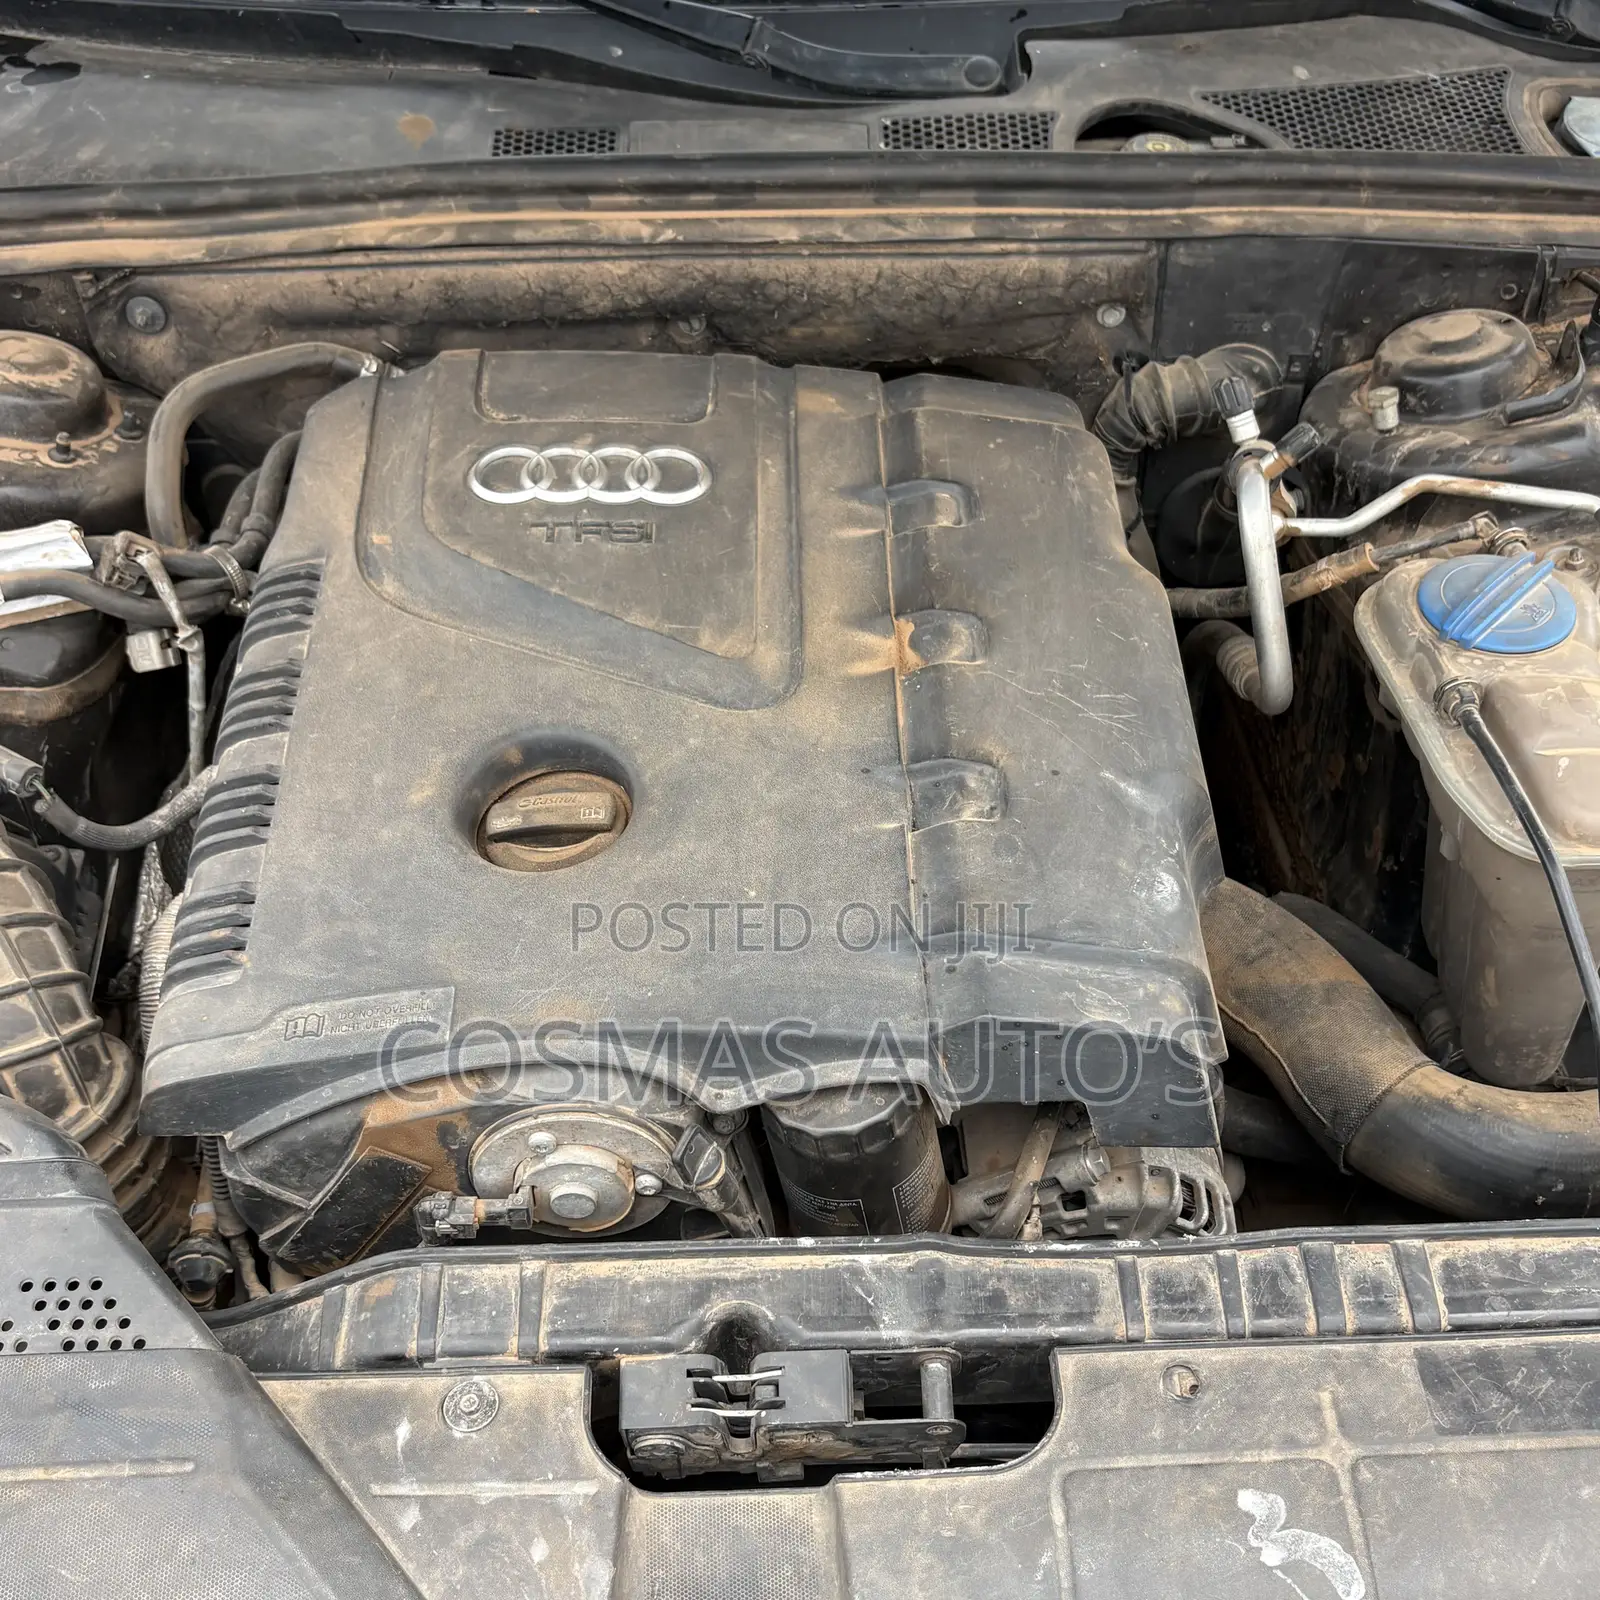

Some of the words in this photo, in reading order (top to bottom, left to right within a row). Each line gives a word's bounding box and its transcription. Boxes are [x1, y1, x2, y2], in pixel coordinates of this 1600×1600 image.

[529, 520, 655, 544] TFSI
[340, 1010, 356, 1020] DO
[359, 1006, 380, 1018] NOT
[330, 1022, 361, 1034] NICHT
